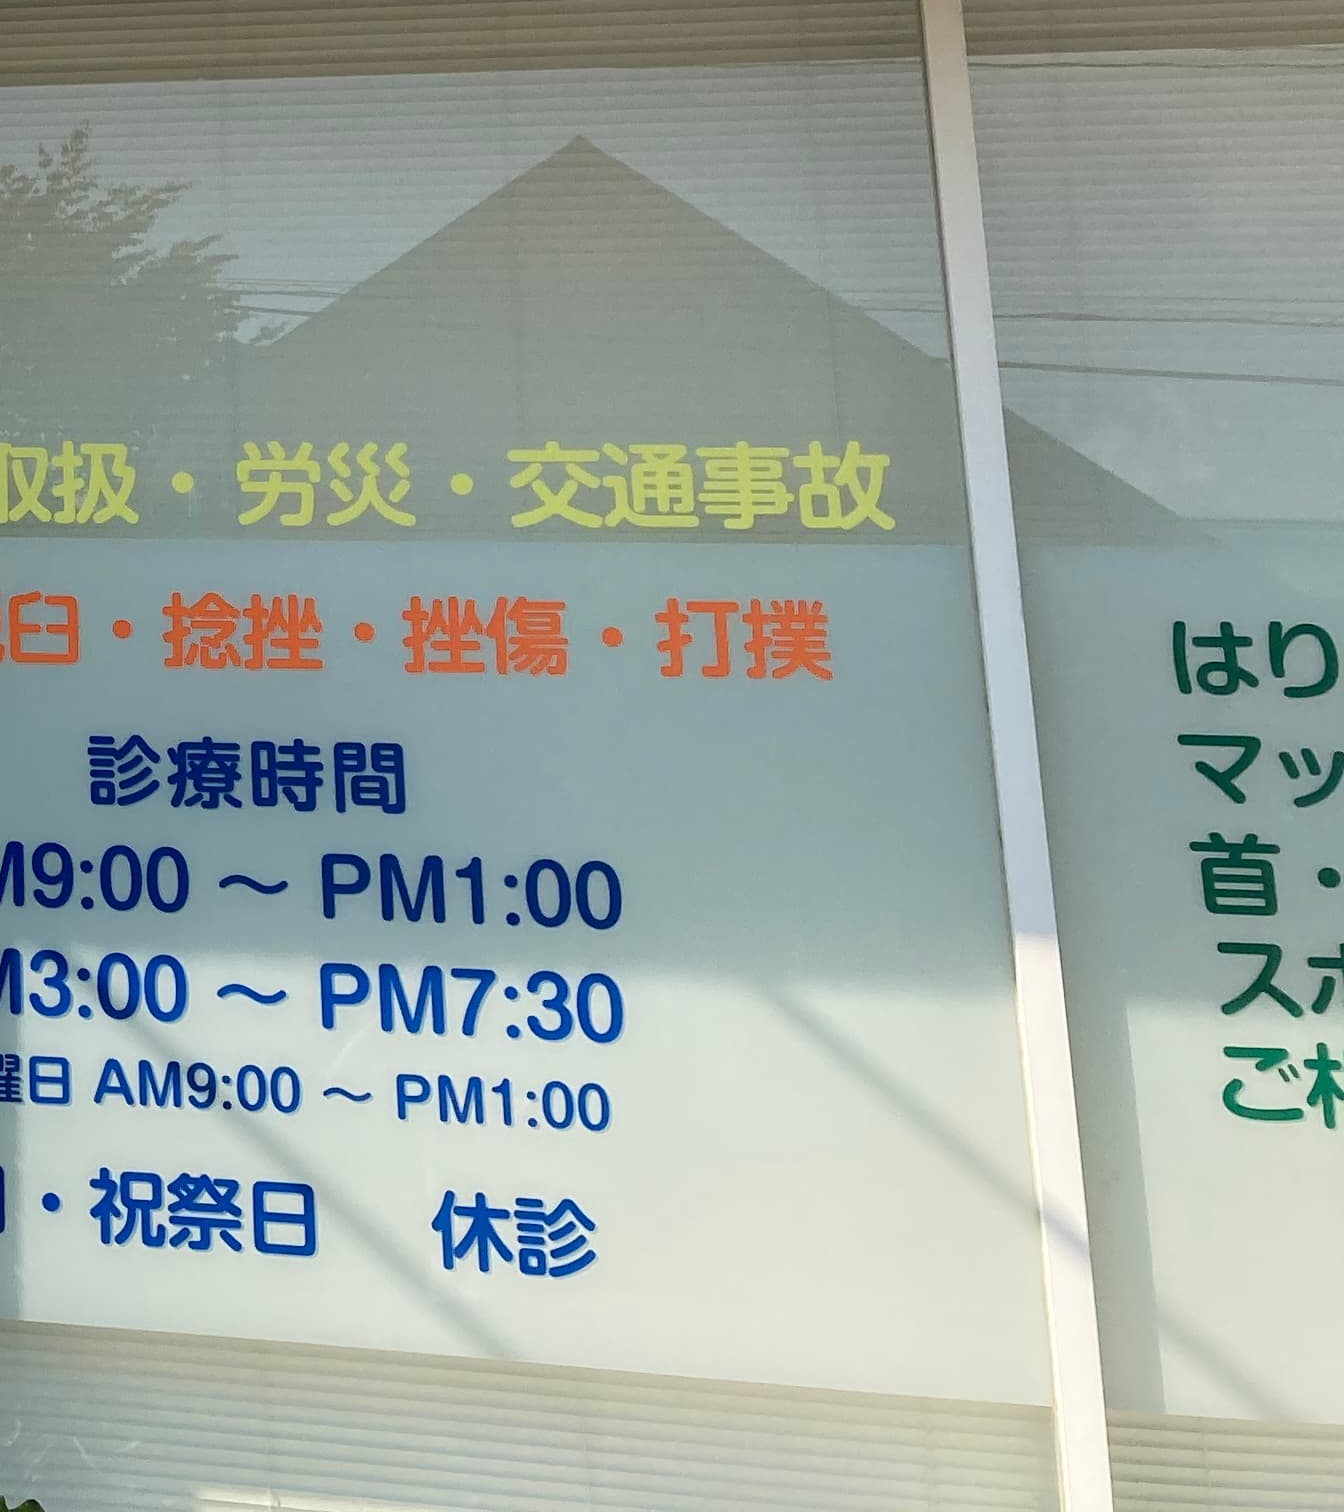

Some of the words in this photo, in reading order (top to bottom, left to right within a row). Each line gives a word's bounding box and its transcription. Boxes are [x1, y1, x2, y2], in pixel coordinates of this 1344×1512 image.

[87, 734, 407, 815] 診療時間
[321, 853, 623, 931] PM1:00
[320, 963, 624, 1044] PM7:30
[94, 1058, 301, 1115] AM9:00
[396, 1074, 611, 1133] PM1:00
[431, 1190, 597, 1279] 休診
